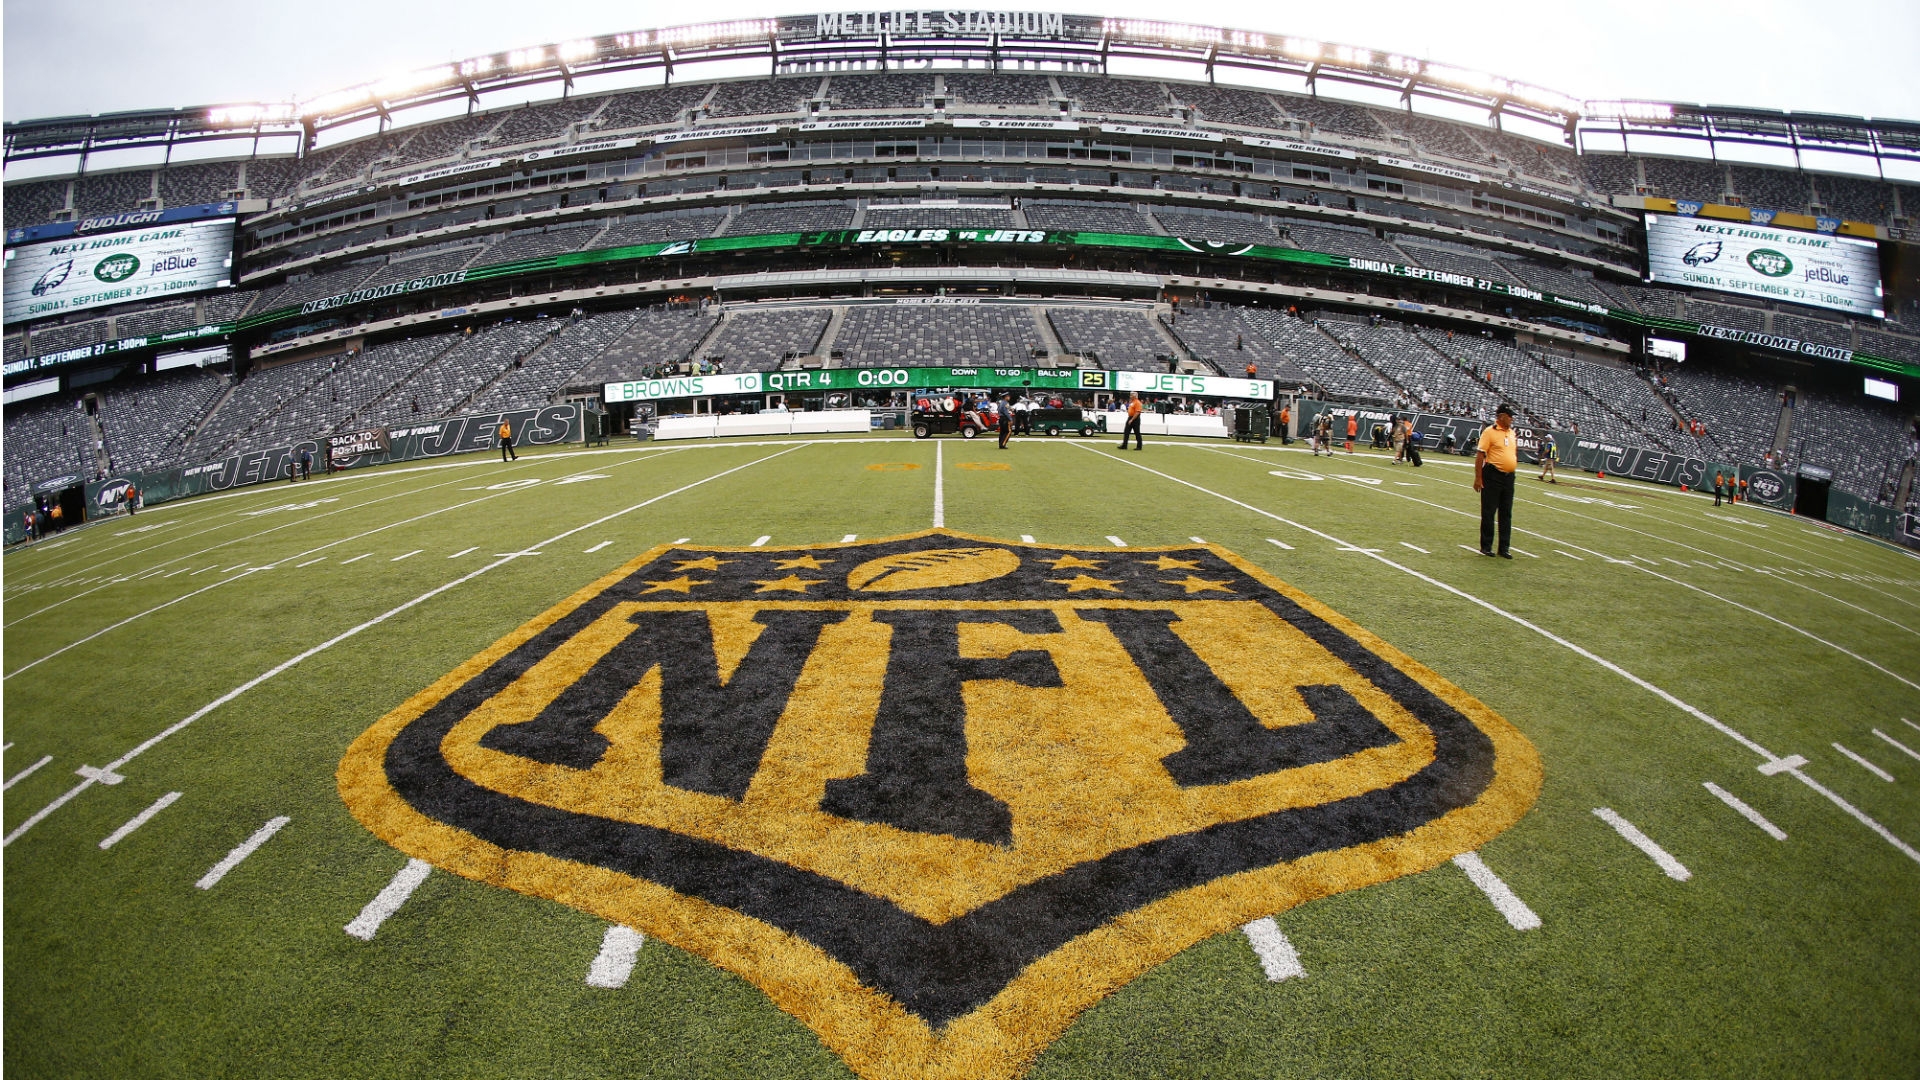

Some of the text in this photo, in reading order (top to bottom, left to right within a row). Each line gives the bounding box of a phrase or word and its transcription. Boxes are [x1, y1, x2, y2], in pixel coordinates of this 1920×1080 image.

[816, 10, 1064, 35] METLIFE STADIUM
[680, 131, 710, 139] MARK
[712, 126, 769, 136] GASTINEAU
[1141, 128, 1186, 136] WINSTON
[423, 169, 451, 179] WAYNE
[1445, 169, 1472, 179] LYONS
[1676, 202, 1700, 215] SAP
[1750, 210, 1772, 223] SAP
[80, 212, 164, 231] BUD LIGHT
[1816, 219, 1837, 232] SAP
[49, 229, 185, 256] NEXT HOME GAME
[857, 229, 949, 243] EAGLES
[984, 230, 1045, 242] JETS
[1695, 224, 1831, 249] NEXT HOME GAME
[150, 256, 198, 276] jetBlue
[1349, 257, 1400, 276] SUNDAY,
[1404, 265, 1474, 288] SEPTEMBER
[1478, 279, 1492, 290] 27
[1507, 284, 1542, 301] 1:00PM
[1805, 265, 1850, 285] jetBlue
[301, 269, 468, 315] NEXT HOME GAME
[1683, 272, 1725, 287] SUNDAY,
[1728, 279, 1789, 297] SEPTEMBER
[1793, 289, 1805, 299] 27
[28, 302, 68, 315] SUNDAY,
[72, 288, 132, 306] SEPTEMBER
[136, 285, 149, 297] 27
[161, 330, 188, 341] Presented
[1697, 324, 1853, 362] NEXT HOME GAME
[3, 359, 37, 375] SUNDAY,
[40, 347, 92, 367] SEPTEMBER
[94, 344, 106, 356] 27
[769, 372, 832, 390] QTR 4
[858, 369, 909, 386] 0:00
[1083, 373, 1104, 386] 25
[1146, 375, 1205, 392] JETS
[1250, 383, 1268, 396] 31
[623, 376, 757, 399] BROWNS 10
[1360, 410, 1393, 421] YORK
[390, 425, 441, 439] EW YORK
[421, 404, 576, 456] JETS
[1520, 429, 1532, 437] TO
[332, 432, 372, 447] BACK TO
[332, 441, 381, 455] FOOTBALL
[1578, 440, 1624, 455] NEW YORK
[184, 462, 223, 477] NEW YORK
[1607, 447, 1706, 487] JETS
[478, 608, 1403, 849] NFL
